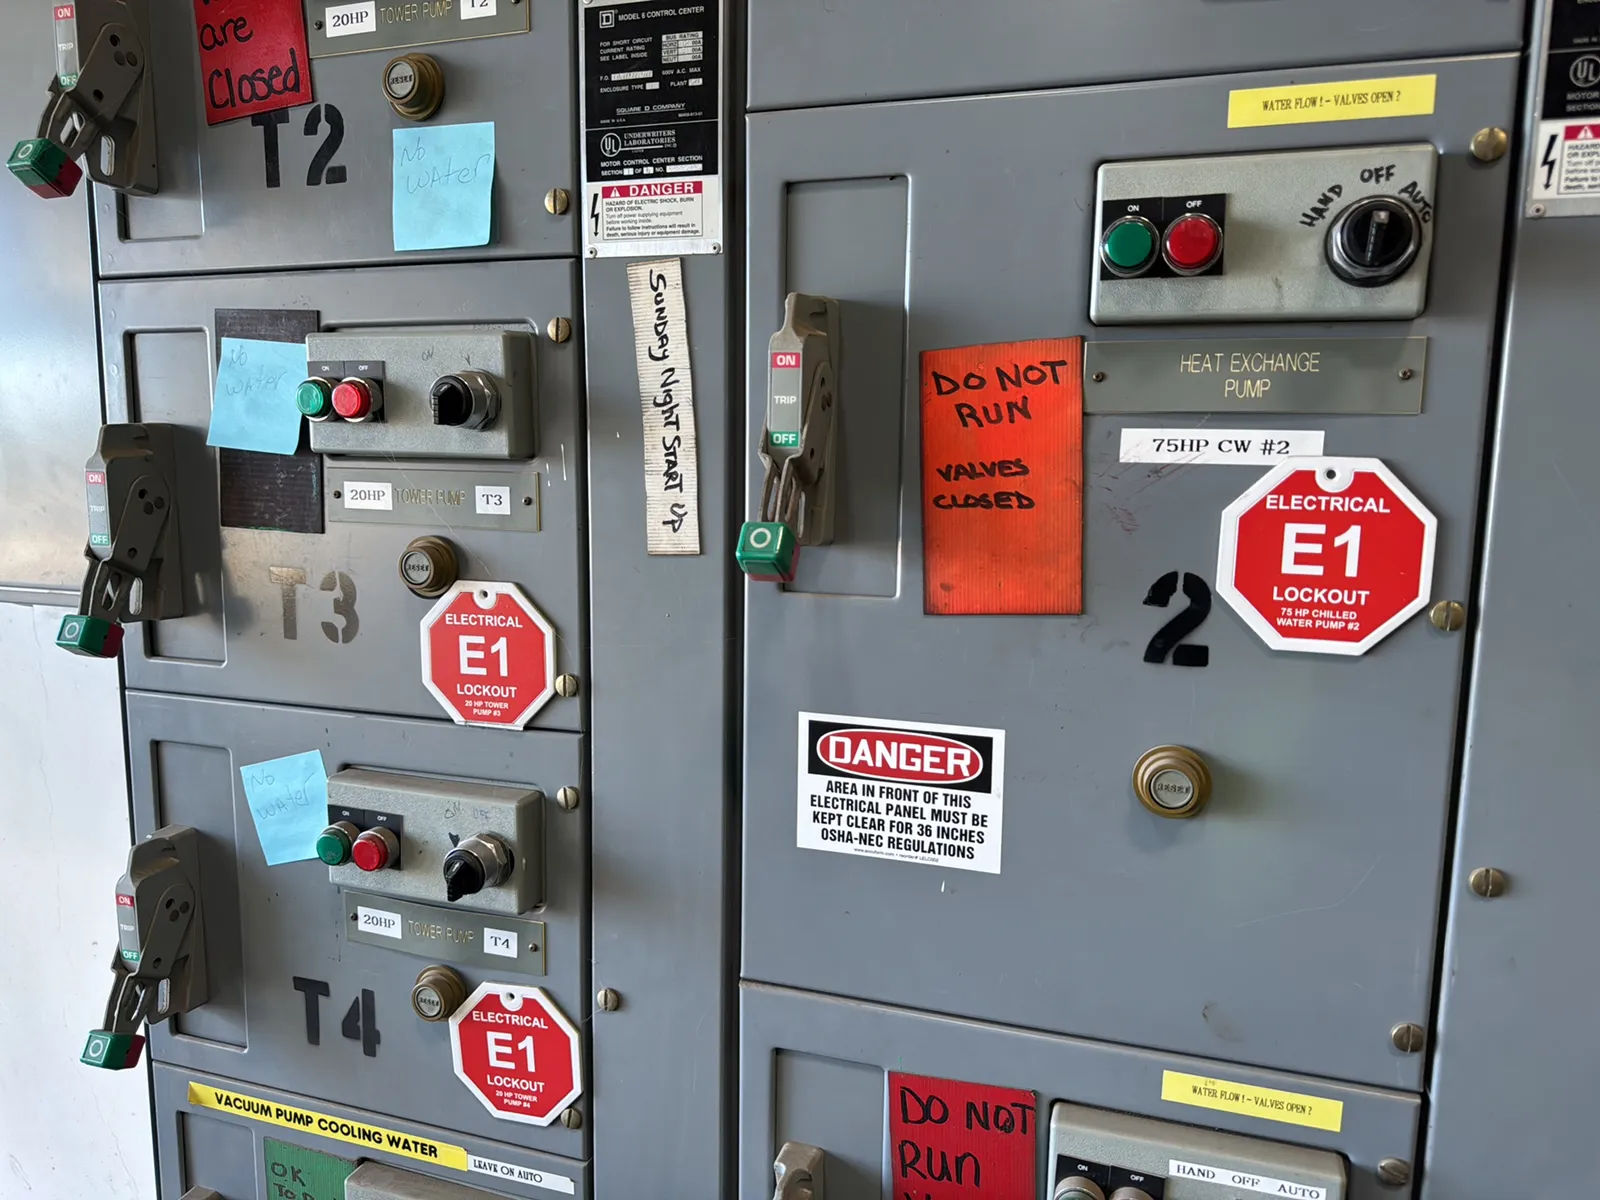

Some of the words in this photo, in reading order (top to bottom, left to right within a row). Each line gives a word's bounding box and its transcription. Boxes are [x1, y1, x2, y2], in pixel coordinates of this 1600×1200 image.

[57, 8, 71, 18] ON
[332, 11, 369, 28] 20HP
[379, 4, 419, 24] TOWER
[422, 1, 453, 19] PUMP
[618, 13, 640, 21] MODEL
[646, 9, 677, 19] CONTROL
[678, 6, 705, 15] CENTER
[200, 16, 254, 51] are
[612, 39, 630, 47] SHORT
[632, 37, 653, 45] CIRCUIT
[58, 42, 74, 52] TRIP
[600, 47, 624, 55] CURRENT
[612, 53, 629, 61] LABEL
[60, 75, 77, 86] OFF
[208, 47, 300, 110] Closed
[600, 85, 629, 93] ENCLOSURE
[616, 106, 642, 114] SQUARE
[652, 102, 686, 111] COMPANY
[1262, 98, 1292, 111] WATER
[1334, 92, 1369, 106] VALVES
[624, 130, 676, 139] UNDERWRITERS
[624, 137, 676, 147] LABORATORIES
[251, 103, 348, 188] T2
[400, 137, 426, 167] No
[652, 157, 675, 165] CENTER
[1360, 164, 1396, 184] OFF
[629, 182, 694, 197] DANGER
[1127, 204, 1140, 213] ON
[1186, 200, 1202, 208] OFF
[1299, 184, 1343, 227] HAND
[1398, 180, 1432, 224] AUTO
[776, 355, 796, 366] ON
[1180, 353, 1224, 373] HEAT
[1230, 352, 1321, 373] EXCHANGE
[931, 370, 987, 396] DO
[995, 359, 1068, 392] NOT
[1224, 379, 1271, 399] PUMP
[774, 395, 797, 405] TRIP
[954, 395, 1032, 428] RUN
[772, 433, 797, 444] OFF
[1152, 438, 1210, 453] 75HP
[1217, 439, 1252, 453] CW
[1260, 439, 1290, 455] #2
[662, 436, 684, 493] START
[936, 458, 1030, 482] VALVES
[88, 473, 102, 483] ON
[350, 488, 386, 501] 20HP
[394, 487, 432, 505] TOWER
[435, 489, 466, 506] PUMP
[481, 493, 503, 506] T3
[932, 490, 1036, 510] CLOSED
[1265, 495, 1391, 513] ELECTRICAL
[89, 505, 105, 513] TRIP
[91, 534, 108, 544] OFF
[1281, 522, 1361, 578] E1
[269, 564, 360, 644] T3
[1272, 586, 1370, 606] LOCKOUT
[445, 613, 523, 628] ELECTRICAL
[1142, 570, 1212, 667] 2
[1280, 607, 1293, 616] 75
[1295, 608, 1310, 617] HP
[1311, 608, 1357, 620] CHILLED
[1276, 617, 1313, 628] WATER
[1315, 620, 1345, 629] PUMP
[1347, 622, 1360, 630] #2
[458, 634, 509, 677] E1
[456, 683, 518, 698] LOCKOUT
[472, 708, 492, 716] PUMP
[484, 701, 509, 709] TOWER
[828, 735, 971, 777] DANGER
[251, 769, 275, 792] No
[825, 780, 858, 796] AREA
[862, 783, 875, 797] IN
[879, 785, 920, 802] FRONT
[923, 790, 939, 805] OF
[942, 793, 972, 809] THIS
[810, 794, 882, 815] ELECTRICAL
[885, 803, 927, 821] PANEL
[931, 808, 967, 825] MUST
[971, 814, 989, 828] BE
[812, 810, 843, 826] KEPT
[846, 814, 885, 832] CLEAR
[889, 820, 913, 835] FOR
[917, 823, 932, 837] 36
[936, 825, 985, 844] INCHES
[821, 827, 884, 847] OSHA-NEC
[887, 836, 975, 860] REGULATIONS
[118, 896, 131, 905] ON
[119, 924, 135, 932] TRIP
[363, 914, 396, 929] 20HP
[408, 920, 442, 939] TOWER
[446, 928, 475, 943] PUMP
[490, 935, 510, 949] T4
[122, 951, 138, 960] OFF
[292, 975, 381, 1058] T4
[472, 1010, 549, 1030] ELECTRICAL
[486, 1030, 536, 1073] E1
[486, 1074, 545, 1093] LOCKOUT
[514, 1092, 538, 1102] TOWER
[1192, 1085, 1218, 1098] WATER
[1254, 1096, 1284, 1110] VALVES
[900, 1086, 949, 1125] DO
[966, 1101, 1036, 1135] NOT
[214, 1091, 272, 1118] VACUUM
[275, 1108, 314, 1127] PUMP
[317, 1118, 383, 1144] COOLING
[386, 1134, 438, 1158] WATER
[271, 1162, 306, 1187] OK
[473, 1158, 498, 1174] LEAVE
[500, 1165, 515, 1177] ON
[517, 1170, 543, 1183] AUTO
[1077, 1164, 1088, 1172] ON
[1130, 1174, 1144, 1182] OFF
[1176, 1164, 1216, 1180] HAND
[1232, 1174, 1260, 1187] OFF
[1277, 1184, 1320, 1199] AUTO
